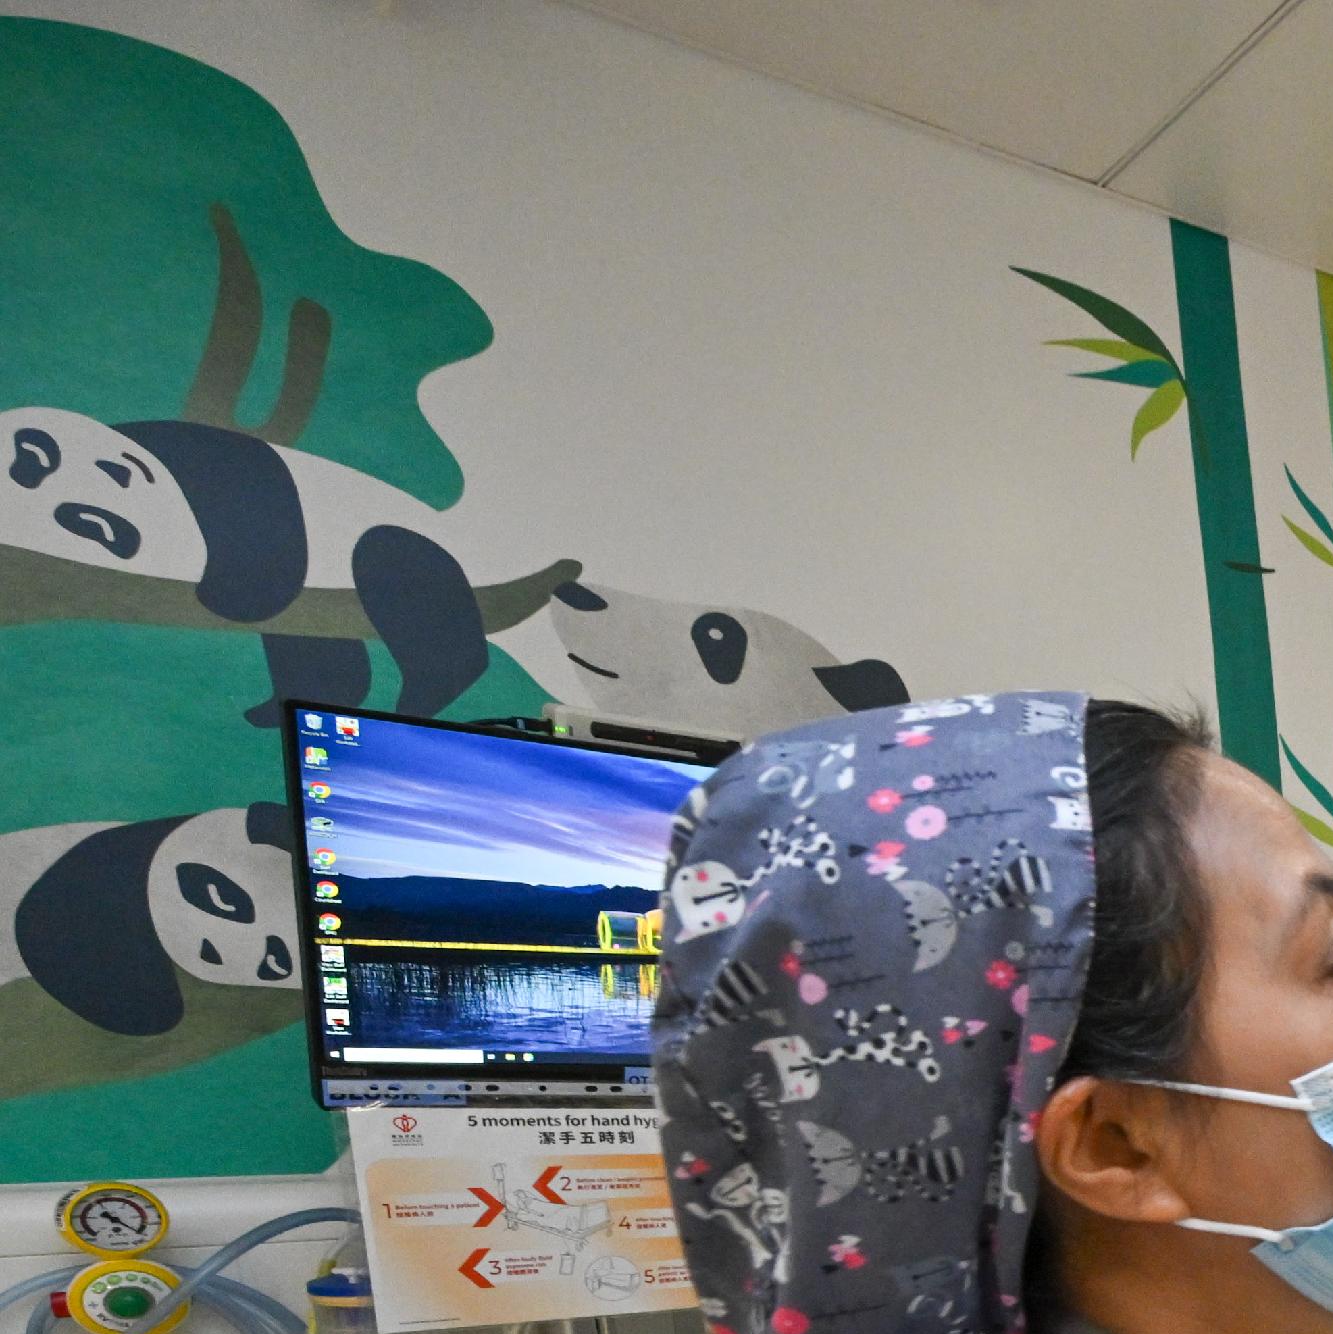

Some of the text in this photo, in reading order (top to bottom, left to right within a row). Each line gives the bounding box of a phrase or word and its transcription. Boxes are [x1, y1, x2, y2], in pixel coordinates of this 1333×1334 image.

[468, 1115, 478, 1127] 5
[482, 1115, 560, 1127] moments
[565, 1114, 587, 1127] for
[591, 1114, 630, 1127] hand
[538, 1131, 635, 1145] 潔手五時刻
[560, 1176, 572, 1191] 2
[382, 1203, 391, 1219] 1
[618, 1216, 631, 1230] 4
[488, 1260, 502, 1276] 3
[644, 1269, 655, 1284] 5
